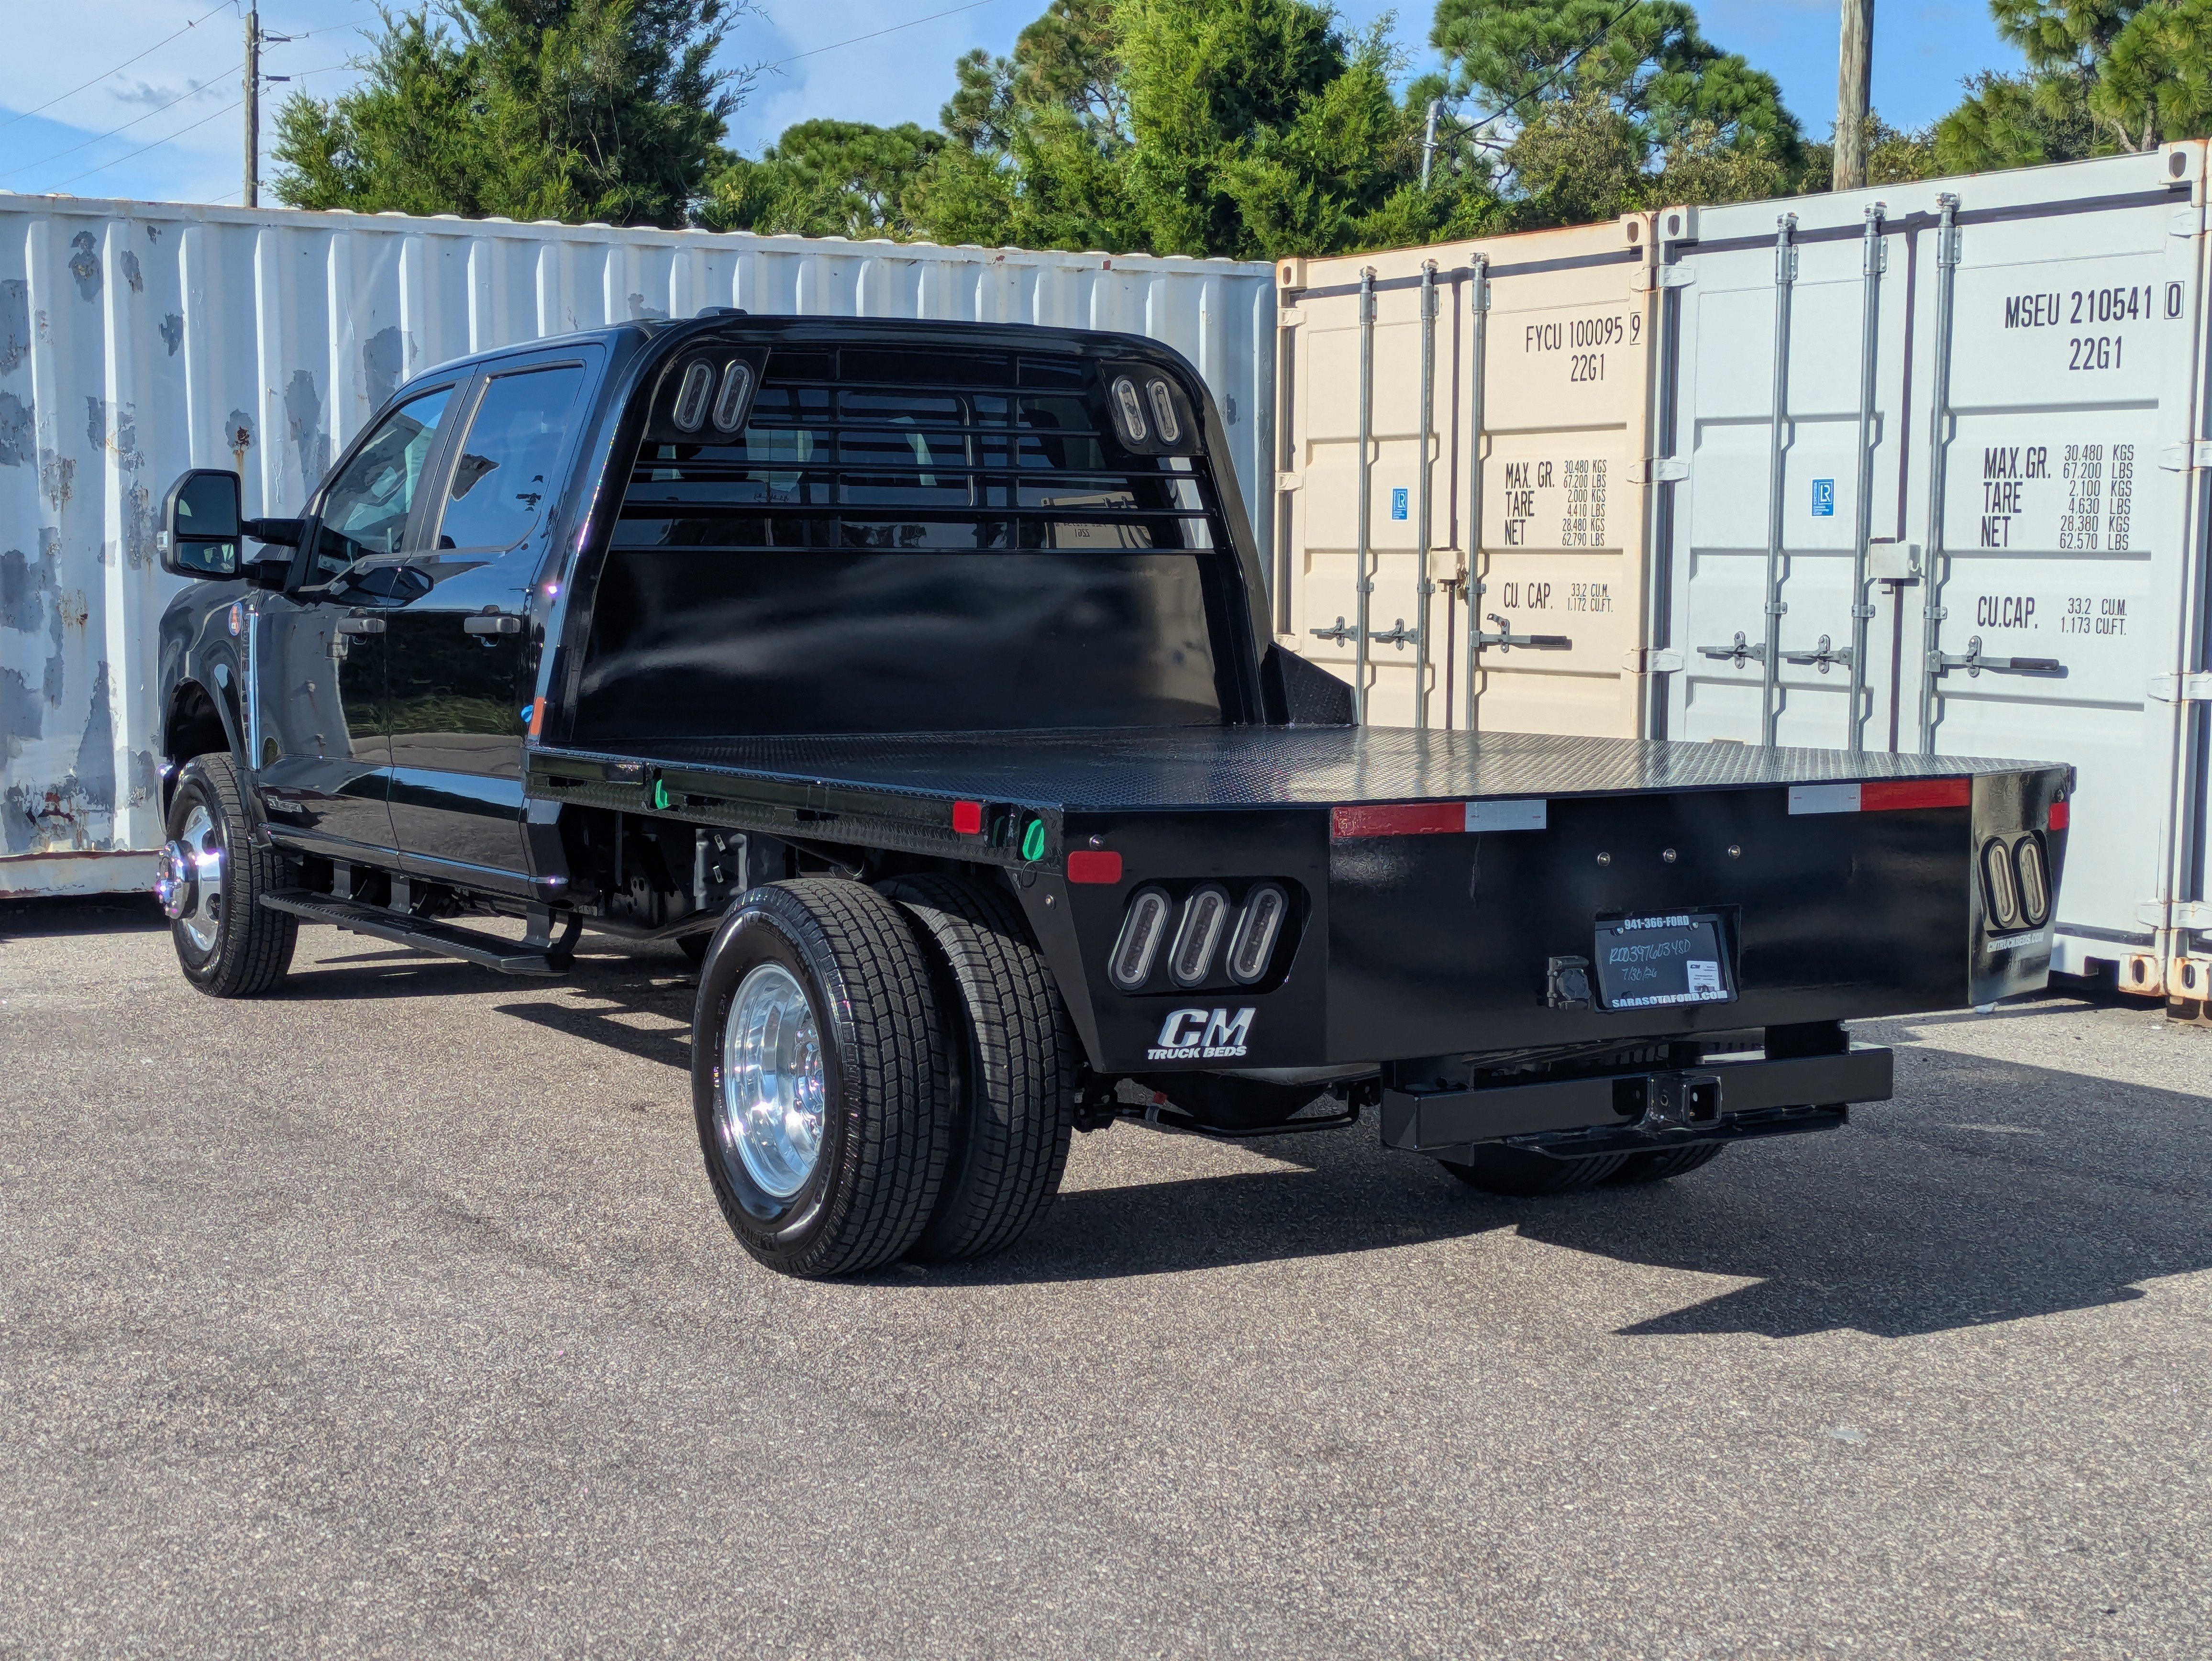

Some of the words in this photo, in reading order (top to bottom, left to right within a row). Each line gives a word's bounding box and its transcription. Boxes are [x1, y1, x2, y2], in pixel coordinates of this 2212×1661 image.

[2005, 293, 2060, 328] MSEU
[2070, 285, 2151, 323] 210541
[1526, 323, 1561, 352] FYCU
[1570, 317, 1623, 348] 100095
[1632, 315, 1640, 342] 9
[2069, 336, 2122, 370] 22G1
[1571, 354, 1604, 382] 22G1
[2113, 444, 2134, 461] KGS
[1538, 461, 1555, 488] GR.
[1593, 459, 1607, 473] KGS
[1592, 475, 1606, 488] LBS
[2112, 463, 2133, 479] LBS
[1505, 491, 1535, 517] TARE
[1592, 489, 1606, 503] KGS
[1983, 482, 2023, 513] TARE
[2111, 480, 2132, 497] KGS
[2109, 498, 2131, 514] LBS
[1591, 504, 1605, 517] LBS
[1505, 519, 1526, 545] NET
[1591, 518, 1605, 532] KGS
[1591, 533, 1605, 546] LBS
[1981, 516, 2011, 547] NET
[2109, 516, 2130, 532] KGS
[2108, 533, 2129, 550] LBS
[1504, 583, 1520, 609] CU.
[1528, 583, 1553, 609] CAP.
[1625, 916, 1689, 930] 941-366-FORD
[1612, 990, 1728, 1008] SARASOTAFORD.COM
[1158, 1008, 1256, 1048] CM
[1148, 1048, 1201, 1060] TRUCK
[1203, 1046, 1247, 1057] BEDS
